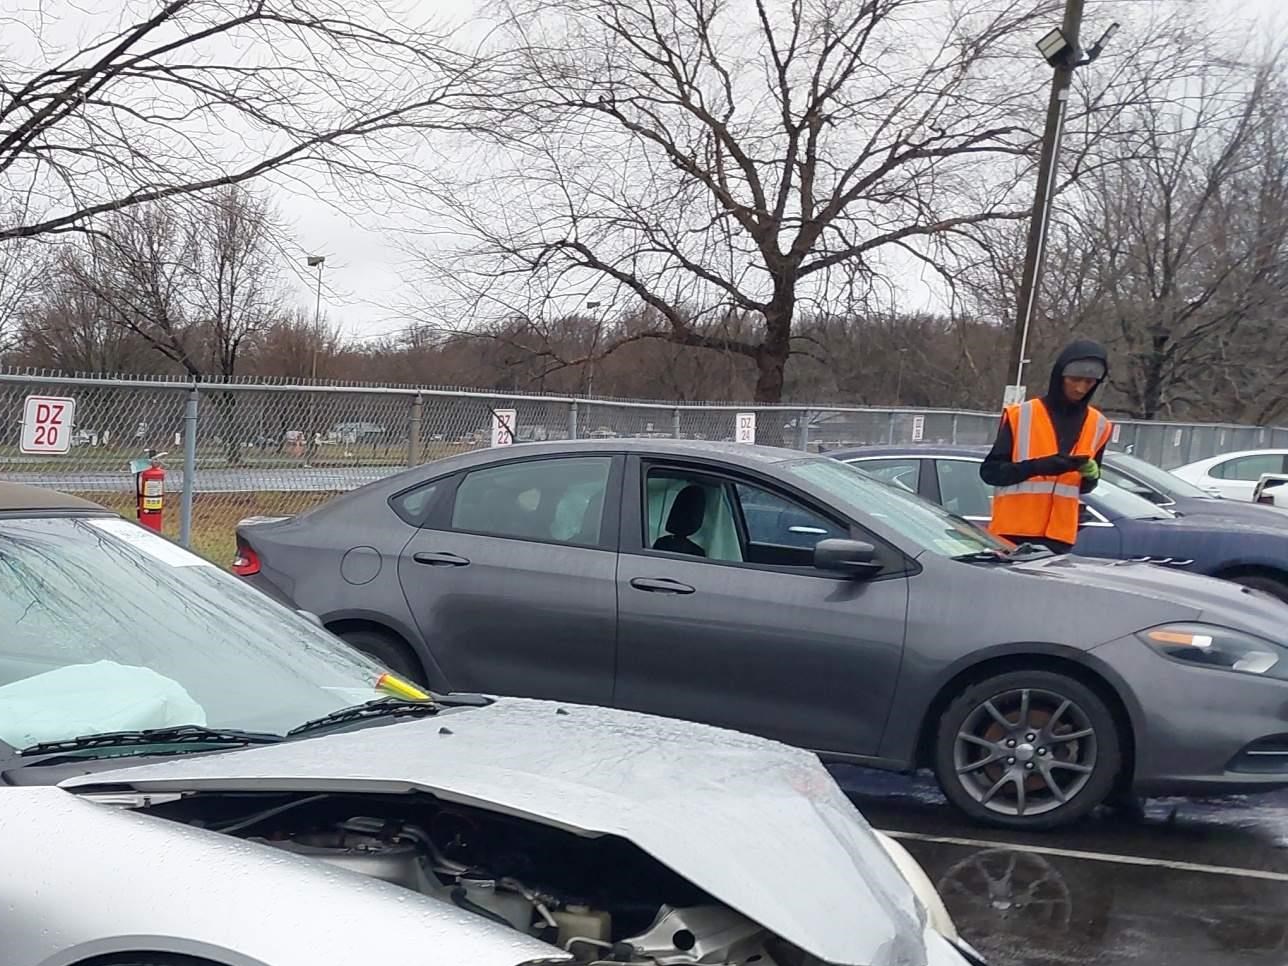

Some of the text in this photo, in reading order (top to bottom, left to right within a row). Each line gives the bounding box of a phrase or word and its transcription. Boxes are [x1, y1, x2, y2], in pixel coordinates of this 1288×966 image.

[35, 404, 65, 425] DZ
[34, 426, 58, 446] 20
[497, 430, 510, 445] 22
